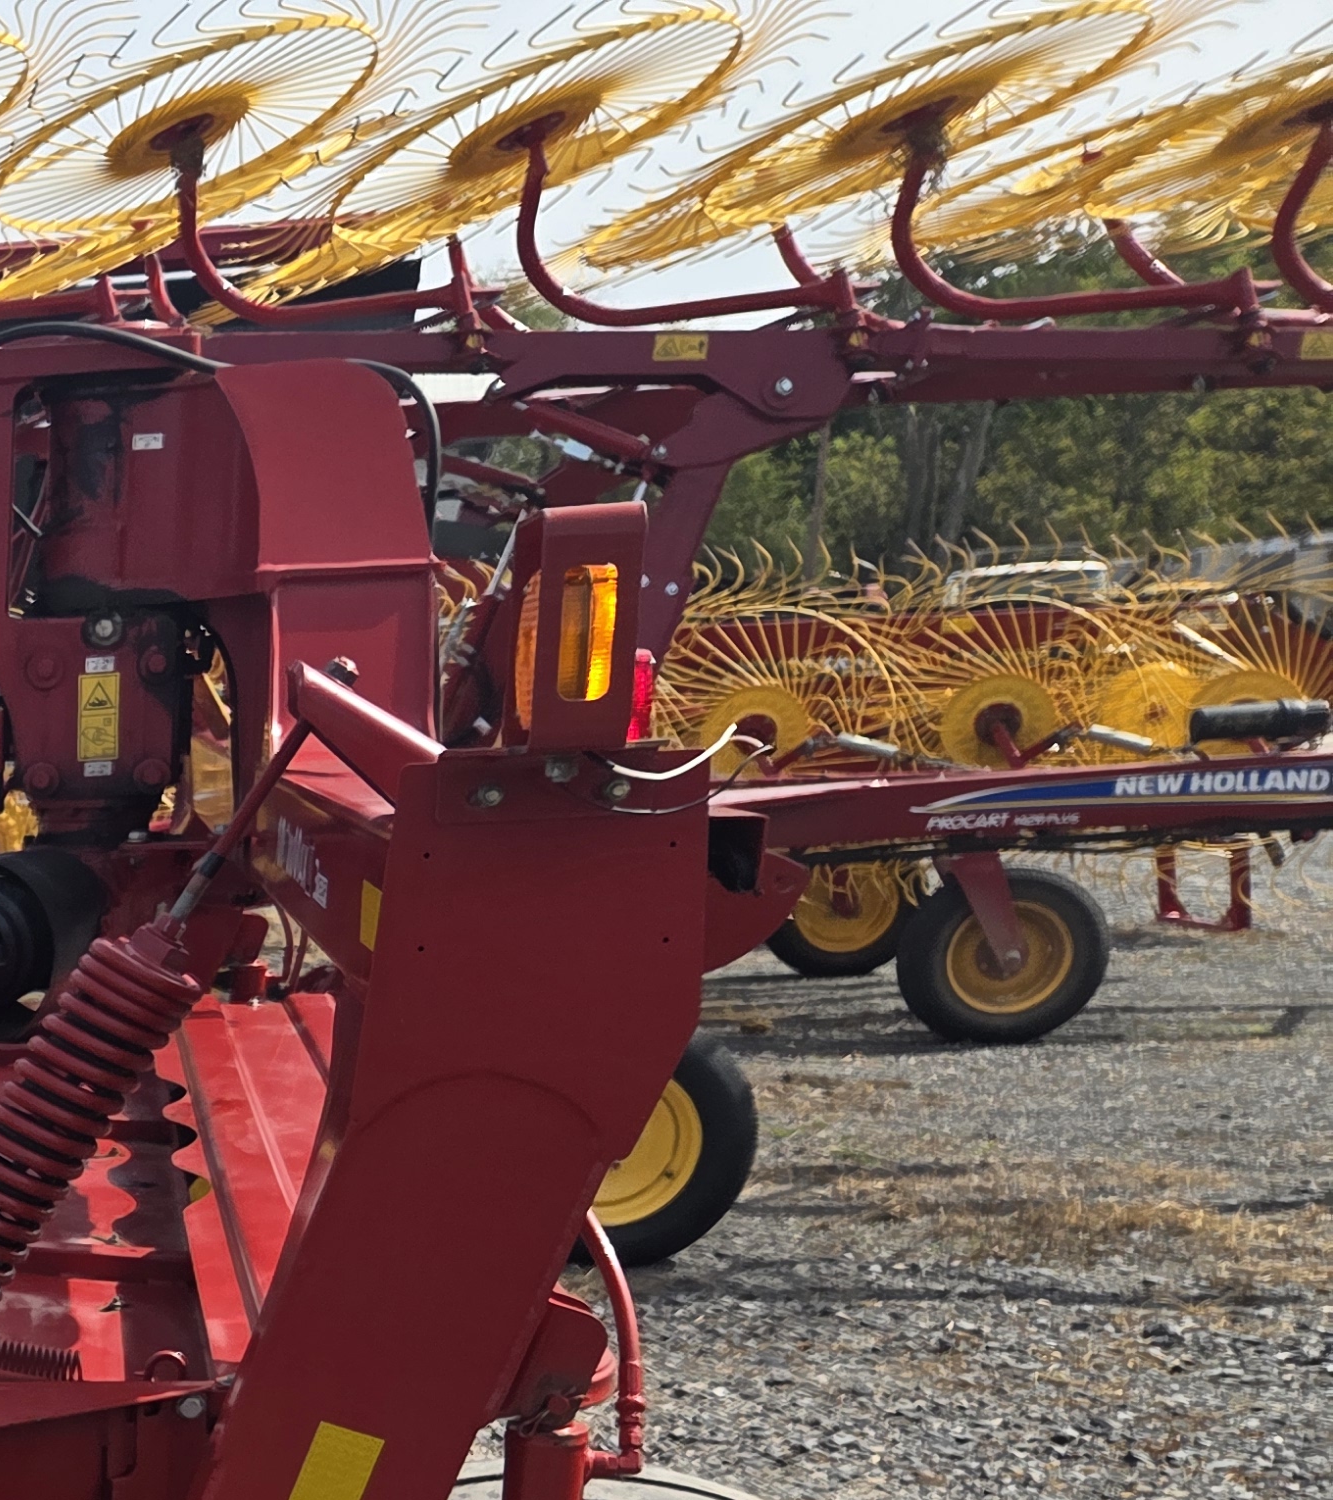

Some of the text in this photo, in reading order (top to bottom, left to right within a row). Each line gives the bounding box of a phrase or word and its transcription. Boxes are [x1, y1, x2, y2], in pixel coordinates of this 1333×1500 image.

[1114, 769, 1330, 796] NEW HOLLAND
[925, 812, 1010, 831] PROCART
